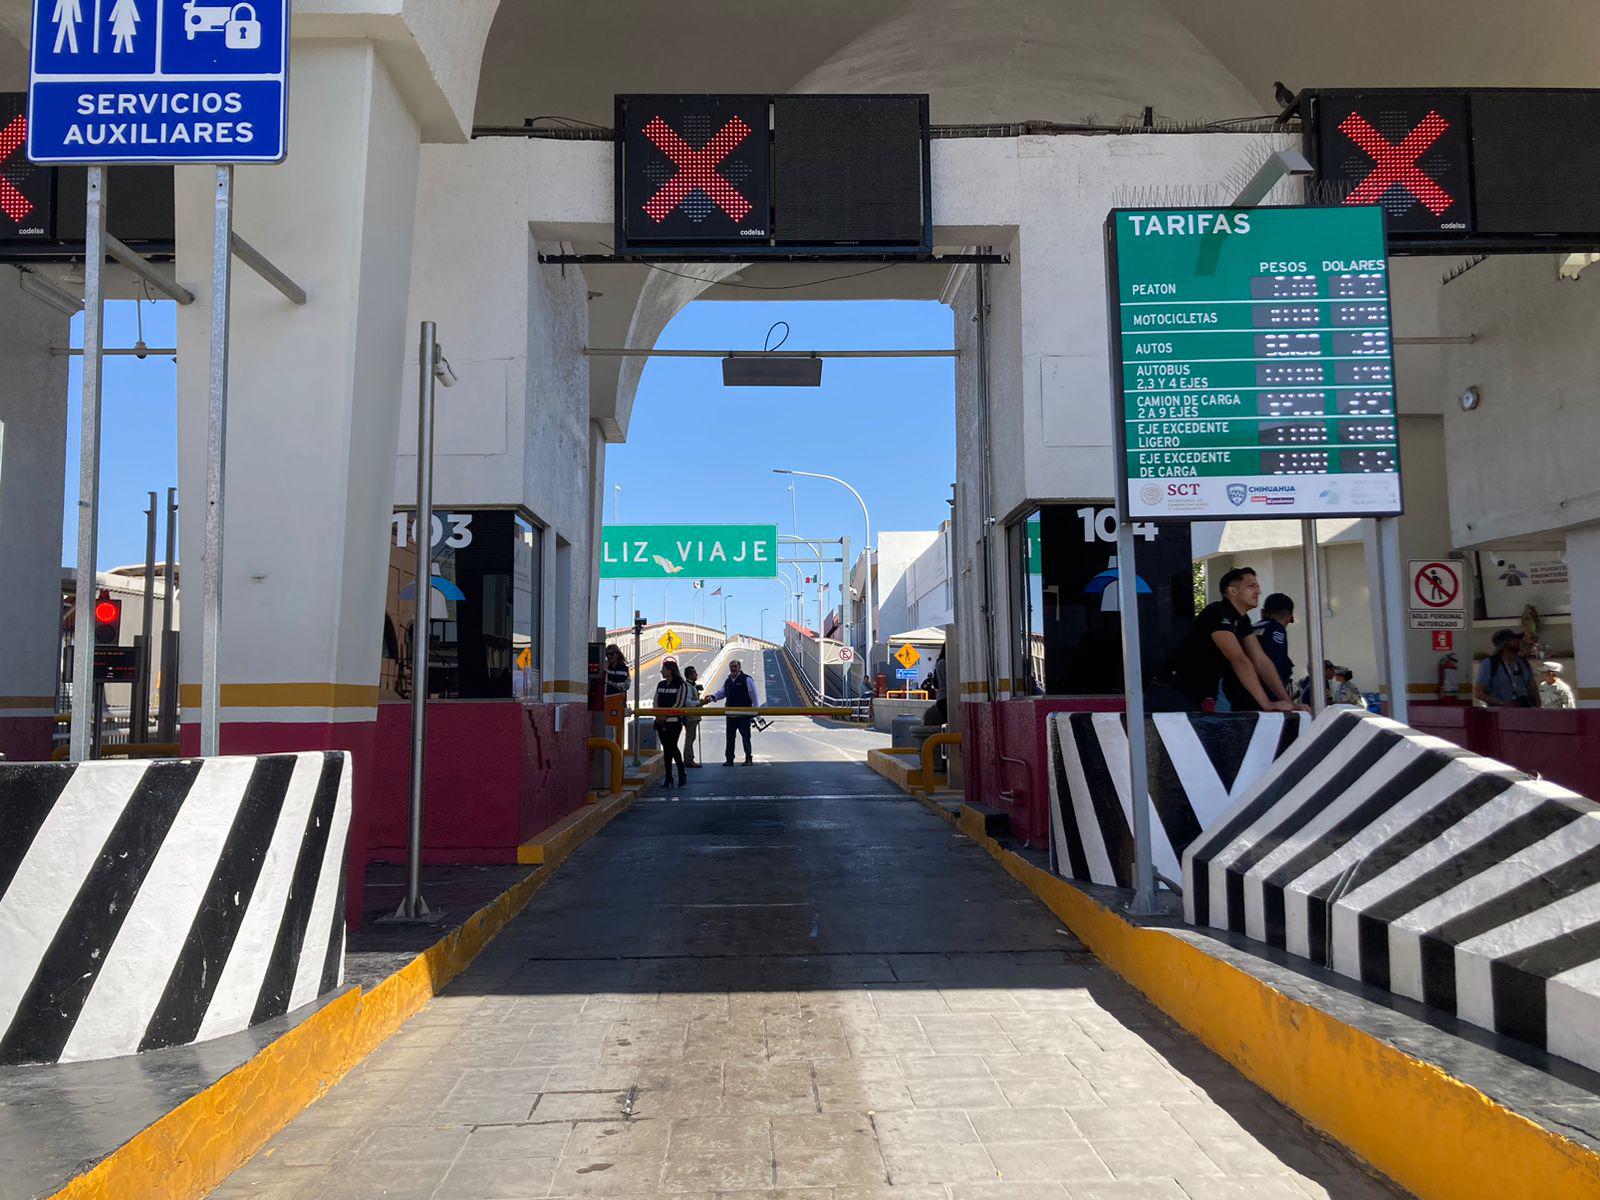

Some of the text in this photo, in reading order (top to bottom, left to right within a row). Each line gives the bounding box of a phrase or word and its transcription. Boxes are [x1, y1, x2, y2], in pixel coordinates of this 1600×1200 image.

[76, 92, 242, 115] SERVICIOS
[62, 122, 254, 145] AUXILIARES
[1128, 213, 1250, 236] TARIFAS
[1259, 261, 1307, 273] PESOS
[1322, 259, 1385, 272] DOLARES
[1132, 283, 1177, 295] PEATON
[1133, 312, 1218, 325] MOTOCICLETAS
[1135, 342, 1173, 355] AUTOS
[1137, 364, 1190, 376] AUTOBUS
[1137, 377, 1208, 390] 2,3 Y 4 EJES
[1137, 393, 1241, 407] CAMION DE CARGA
[1137, 406, 1199, 419] 2 A 9 EJES
[1138, 422, 1230, 435] EJE EXCEDENTE
[1138, 436, 1180, 448] LIGERO
[1139, 452, 1231, 465] EJE EXCEDENTE
[1140, 465, 1198, 478] DE CARGA
[1168, 483, 1200, 496] SCT
[1248, 485, 1296, 493] CHIHUAHUA
[676, 540, 768, 563] VIAJE
